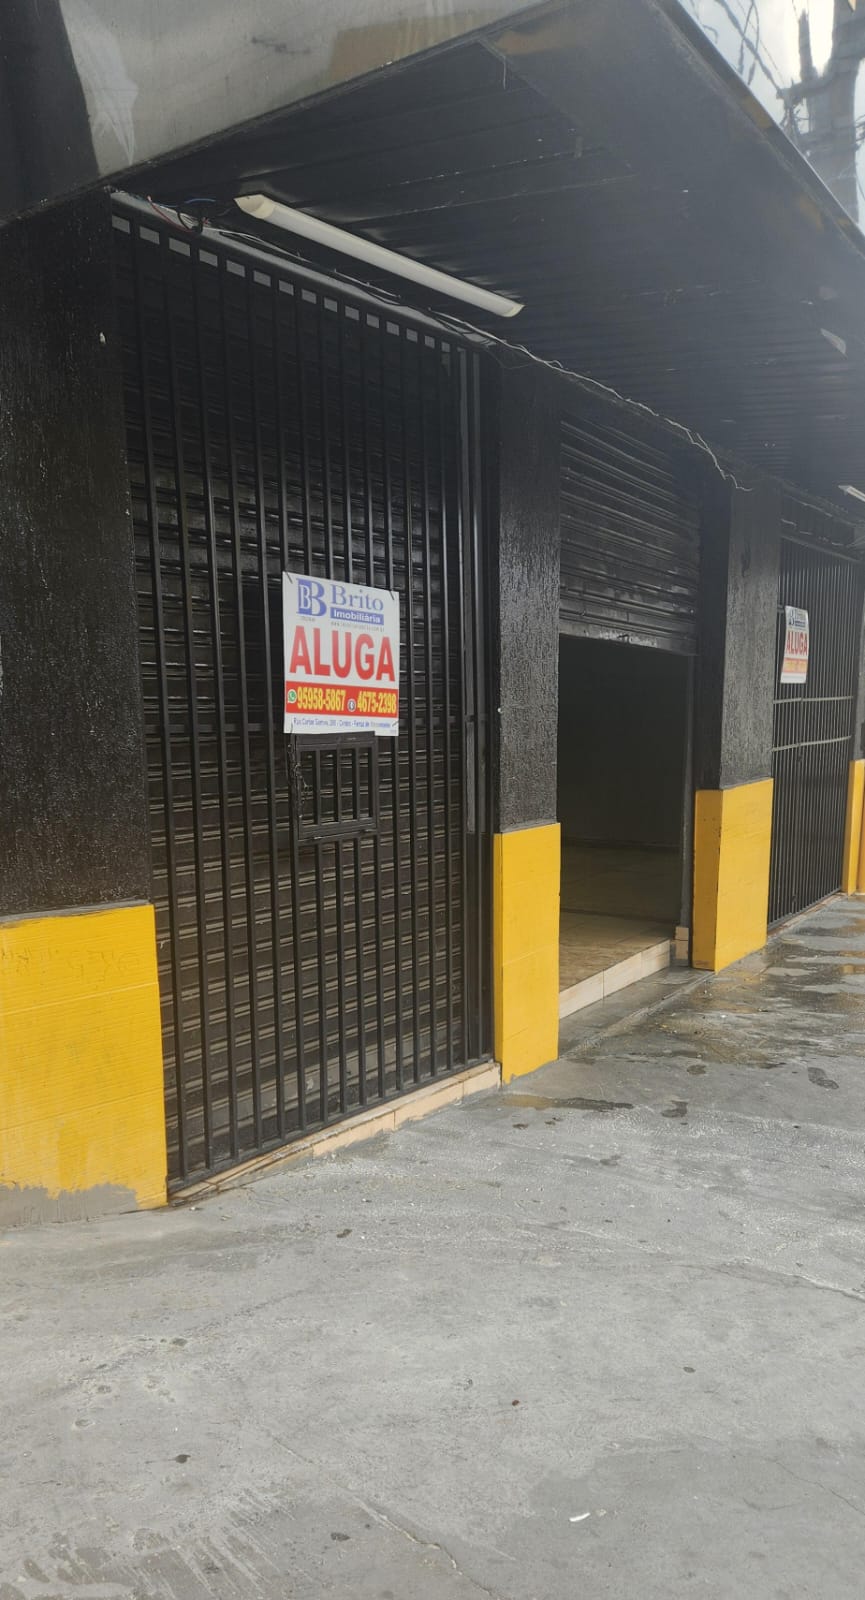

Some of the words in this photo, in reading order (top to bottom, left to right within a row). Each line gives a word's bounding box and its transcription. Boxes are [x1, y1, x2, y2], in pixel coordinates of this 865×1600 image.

[331, 584, 384, 611] Brito
[333, 609, 381, 624] Imobiliária
[289, 625, 396, 682] ALUGA
[786, 630, 808, 656] ALUGA
[297, 686, 346, 711] 95958-5867
[357, 691, 397, 714] 4675-2398
